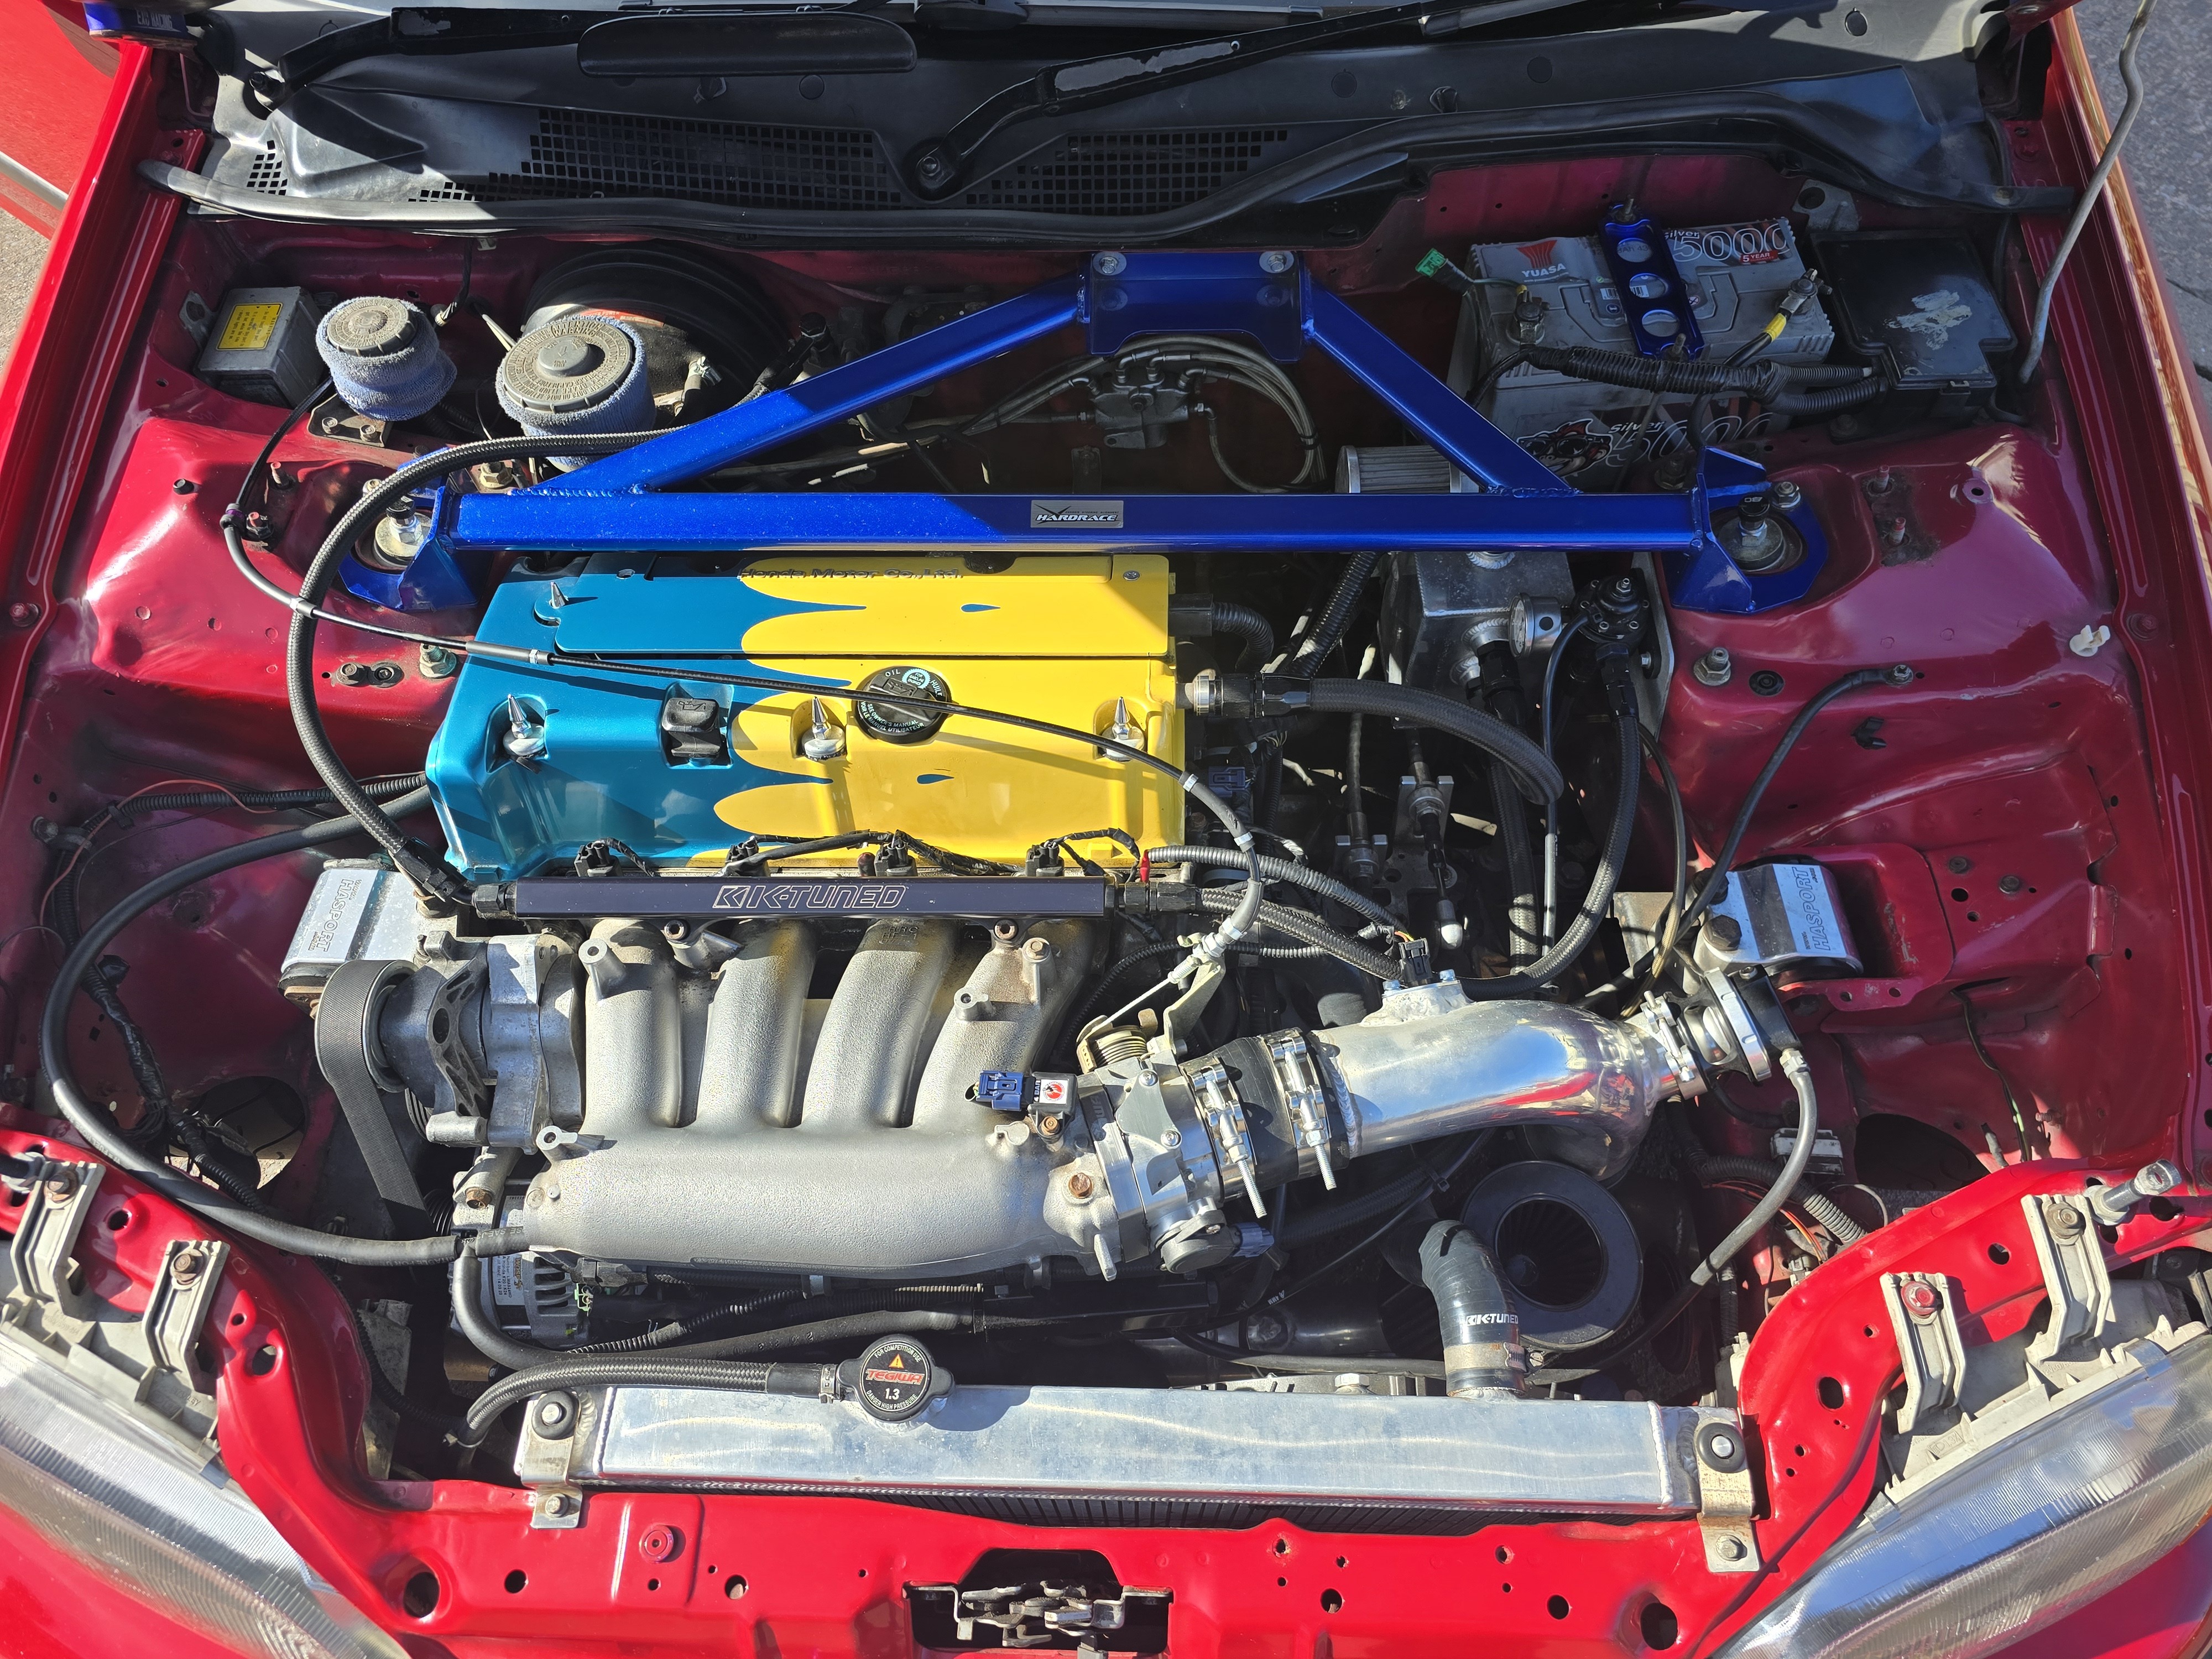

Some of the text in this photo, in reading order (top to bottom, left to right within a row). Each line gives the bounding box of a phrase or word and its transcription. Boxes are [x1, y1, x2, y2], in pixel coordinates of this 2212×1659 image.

[151, 13, 173, 29] RACING
[1672, 222, 1790, 262] 5000
[1522, 263, 1566, 277] YUASA
[549, 321, 605, 332] ATTENTION
[552, 327, 599, 338] WARNING
[738, 568, 806, 579] Honda
[811, 568, 878, 578] Motor
[885, 669, 943, 697] OIL HUILE
[867, 717, 886, 731] MANUEL
[888, 722, 925, 733] UTILISATEUR
[872, 711, 893, 727] OWNER'S
[893, 719, 919, 728] MANUAL
[746, 885, 906, 908] K-TUNED
[316, 879, 354, 952] HASPORT
[1792, 867, 1831, 951] HASPORT
[488, 1228, 505, 1238] SAE
[1267, 1295, 1279, 1305] 4MM
[1476, 1313, 1519, 1324] K-TUNED
[874, 1344, 922, 1363] FOR COMPETITION USE
[865, 1369, 925, 1385] TEGIWA
[866, 1390, 881, 1406] DANGER
[893, 1394, 917, 1410] PRESSURE
[885, 1387, 900, 1400] 1.3
